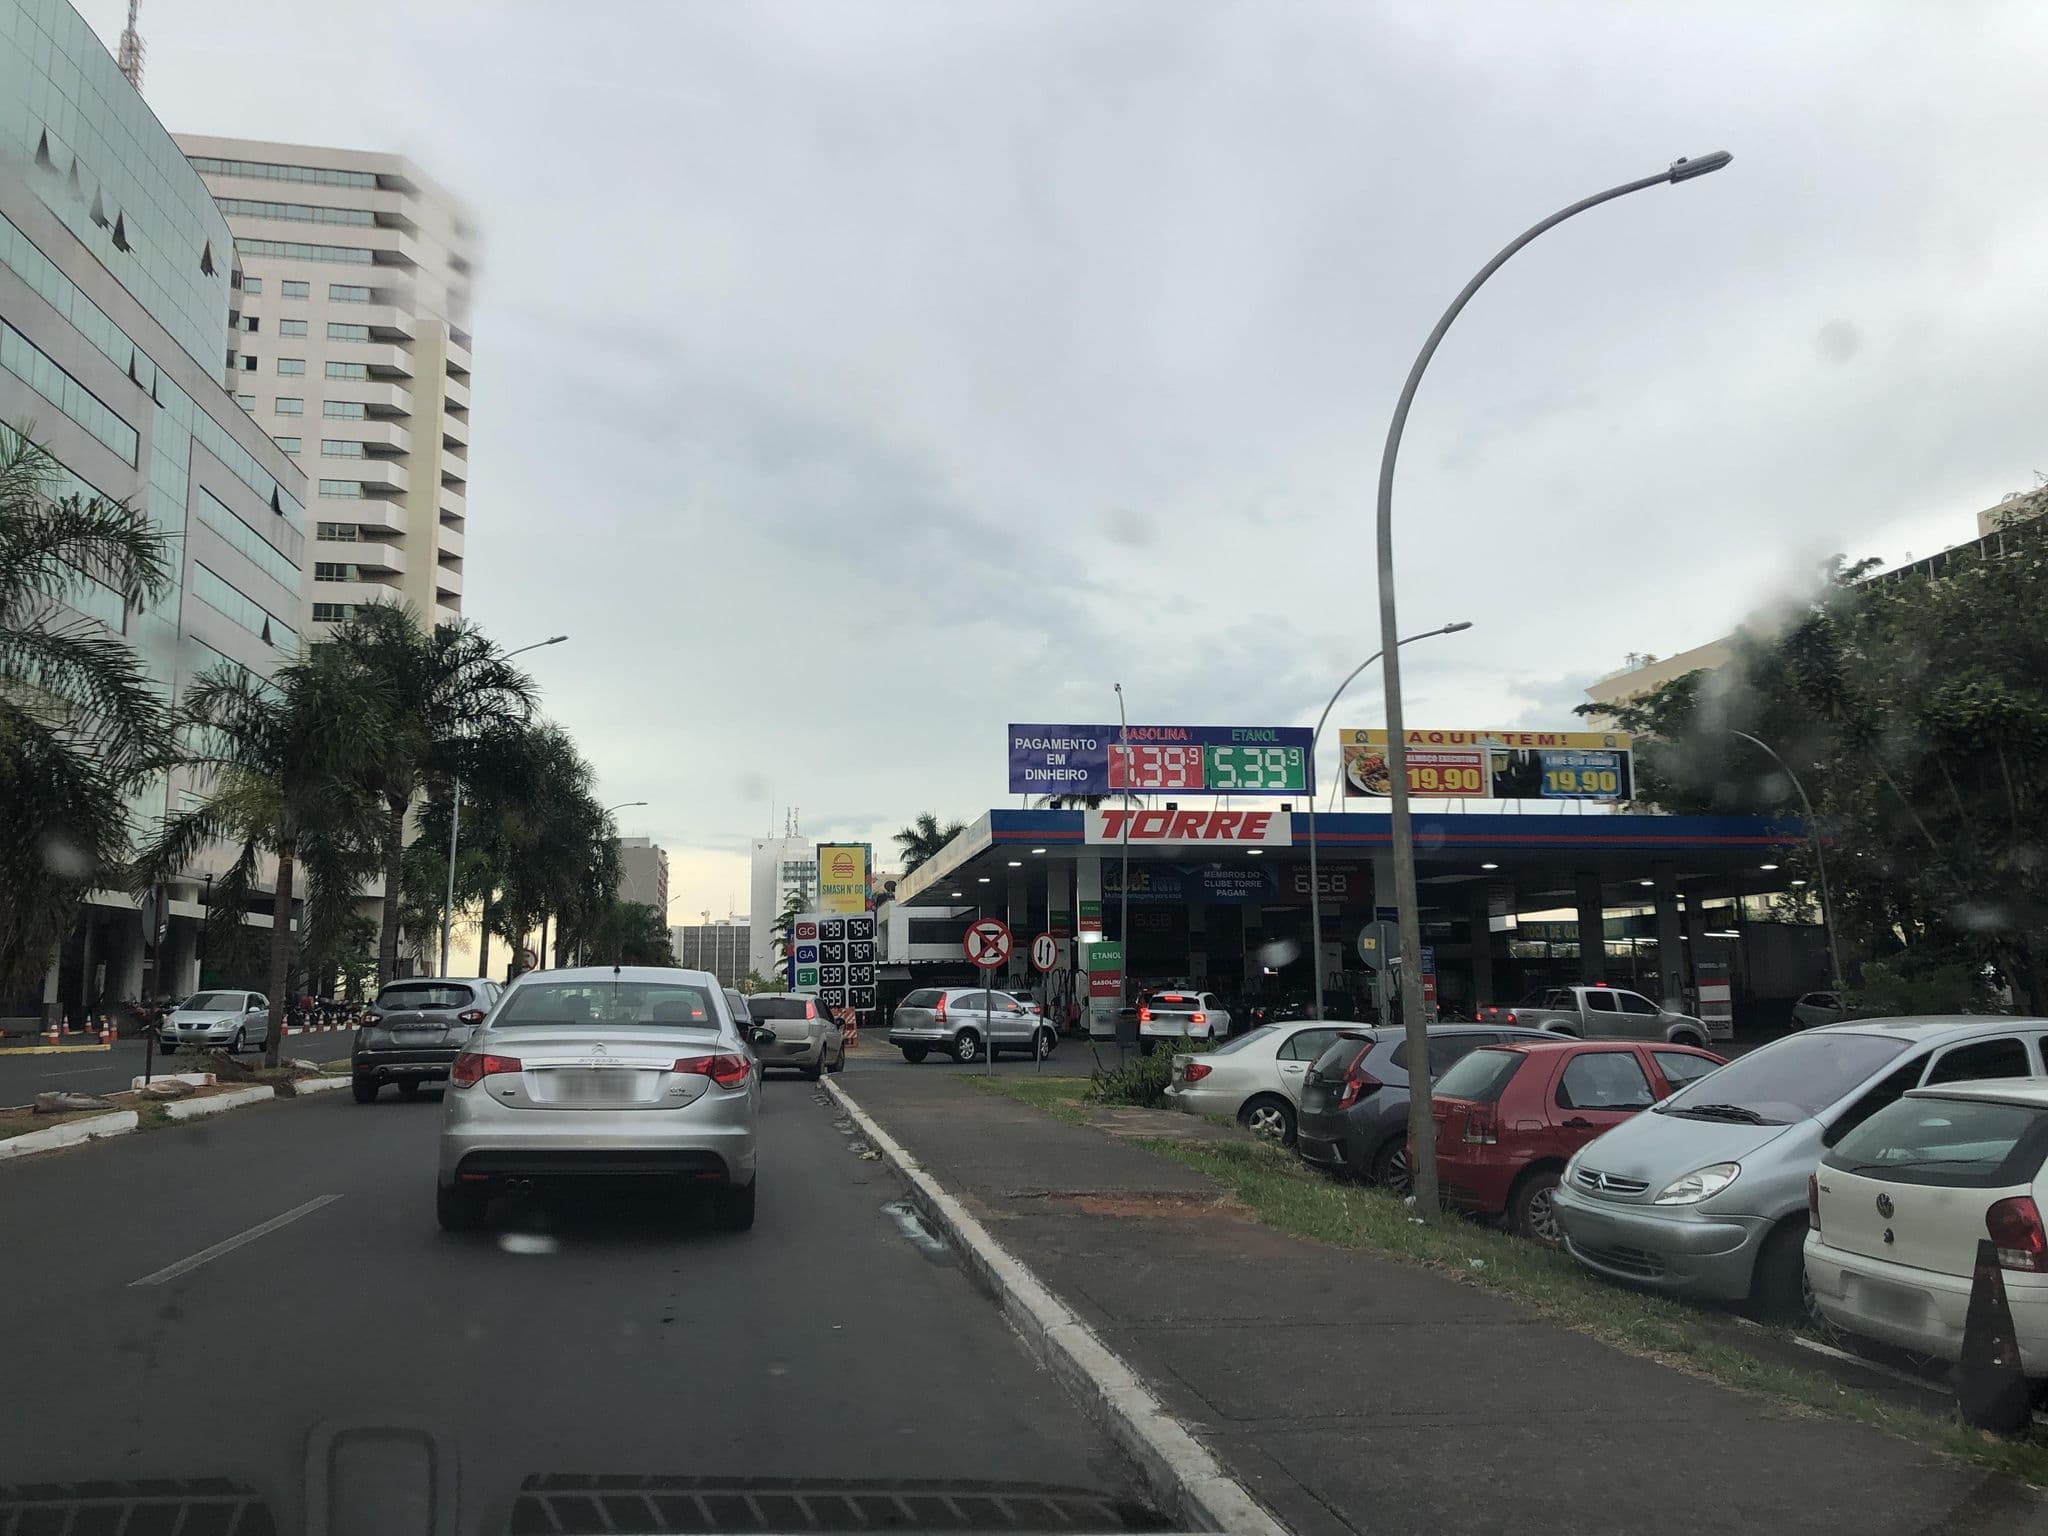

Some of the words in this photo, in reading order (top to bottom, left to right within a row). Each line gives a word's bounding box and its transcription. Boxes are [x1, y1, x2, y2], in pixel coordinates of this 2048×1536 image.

[1231, 729, 1279, 741] ETANOL
[1501, 734, 1568, 746] TEM!
[1015, 738, 1097, 751] PAGAMENTO
[1046, 754, 1066, 765] EM
[1025, 769, 1088, 780] DINHEIRO
[1407, 768, 1480, 791] 19,90
[1545, 770, 1616, 792] 19,90
[1101, 810, 1272, 839] TORRE
[822, 885, 845, 895] SMASH
[855, 885, 864, 894] GO
[799, 927, 815, 936] GC
[799, 950, 815, 959] GA
[800, 973, 814, 982] ET
